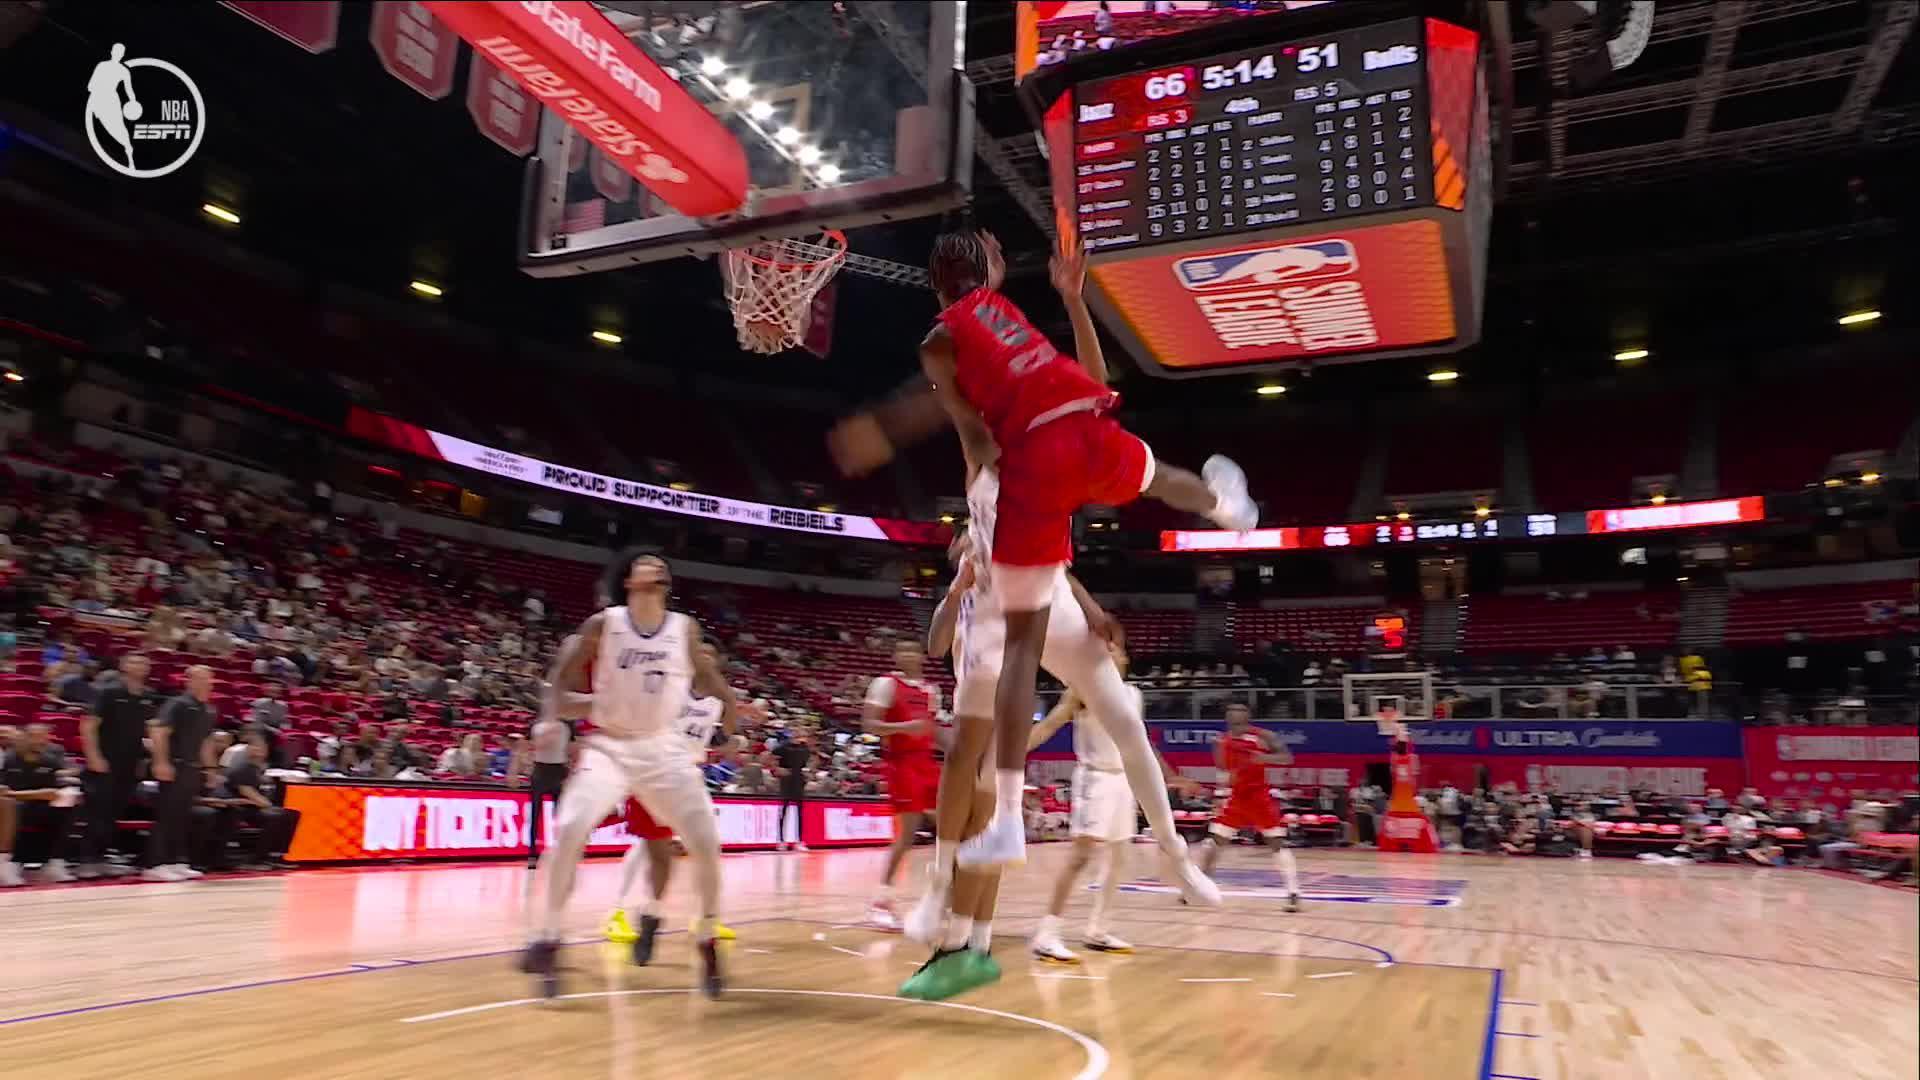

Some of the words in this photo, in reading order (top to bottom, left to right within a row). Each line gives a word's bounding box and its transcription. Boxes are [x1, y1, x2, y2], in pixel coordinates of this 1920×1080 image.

[1297, 42, 1339, 72] 51
[1203, 55, 1278, 90] 5:14
[1145, 73, 1187, 100] 66
[1323, 81, 1339, 97] 5
[1174, 109, 1188, 123] 3
[1398, 107, 1412, 122] 2
[1372, 131, 1384, 145] 1
[1148, 150, 1160, 163] 2
[1170, 145, 1183, 159] 5
[1193, 142, 1206, 155] 2
[1219, 138, 1231, 151] 1
[1148, 168, 1161, 181] 2
[1171, 164, 1184, 177] 2
[1195, 160, 1206, 173] 1
[1219, 156, 1232, 169] 6
[1319, 159, 1333, 173] 9
[1372, 152, 1385, 165] 1
[1171, 183, 1185, 196] 3
[1196, 180, 1207, 193] 1
[1221, 175, 1233, 189] 2
[1321, 178, 1335, 193] 2
[1321, 197, 1336, 212] 3
[1403, 186, 1416, 200] 1
[1172, 220, 1185, 233] 3
[1197, 216, 1209, 230] 2
[1223, 213, 1234, 226] 1
[1194, 289, 1300, 349] LEAGUE
[1278, 281, 1379, 351] SUMMER
[543, 465, 608, 493] PROUD
[614, 482, 721, 513] SUPPORTER
[769, 508, 845, 532] REBELS
[1493, 730, 1579, 746] ULTRA
